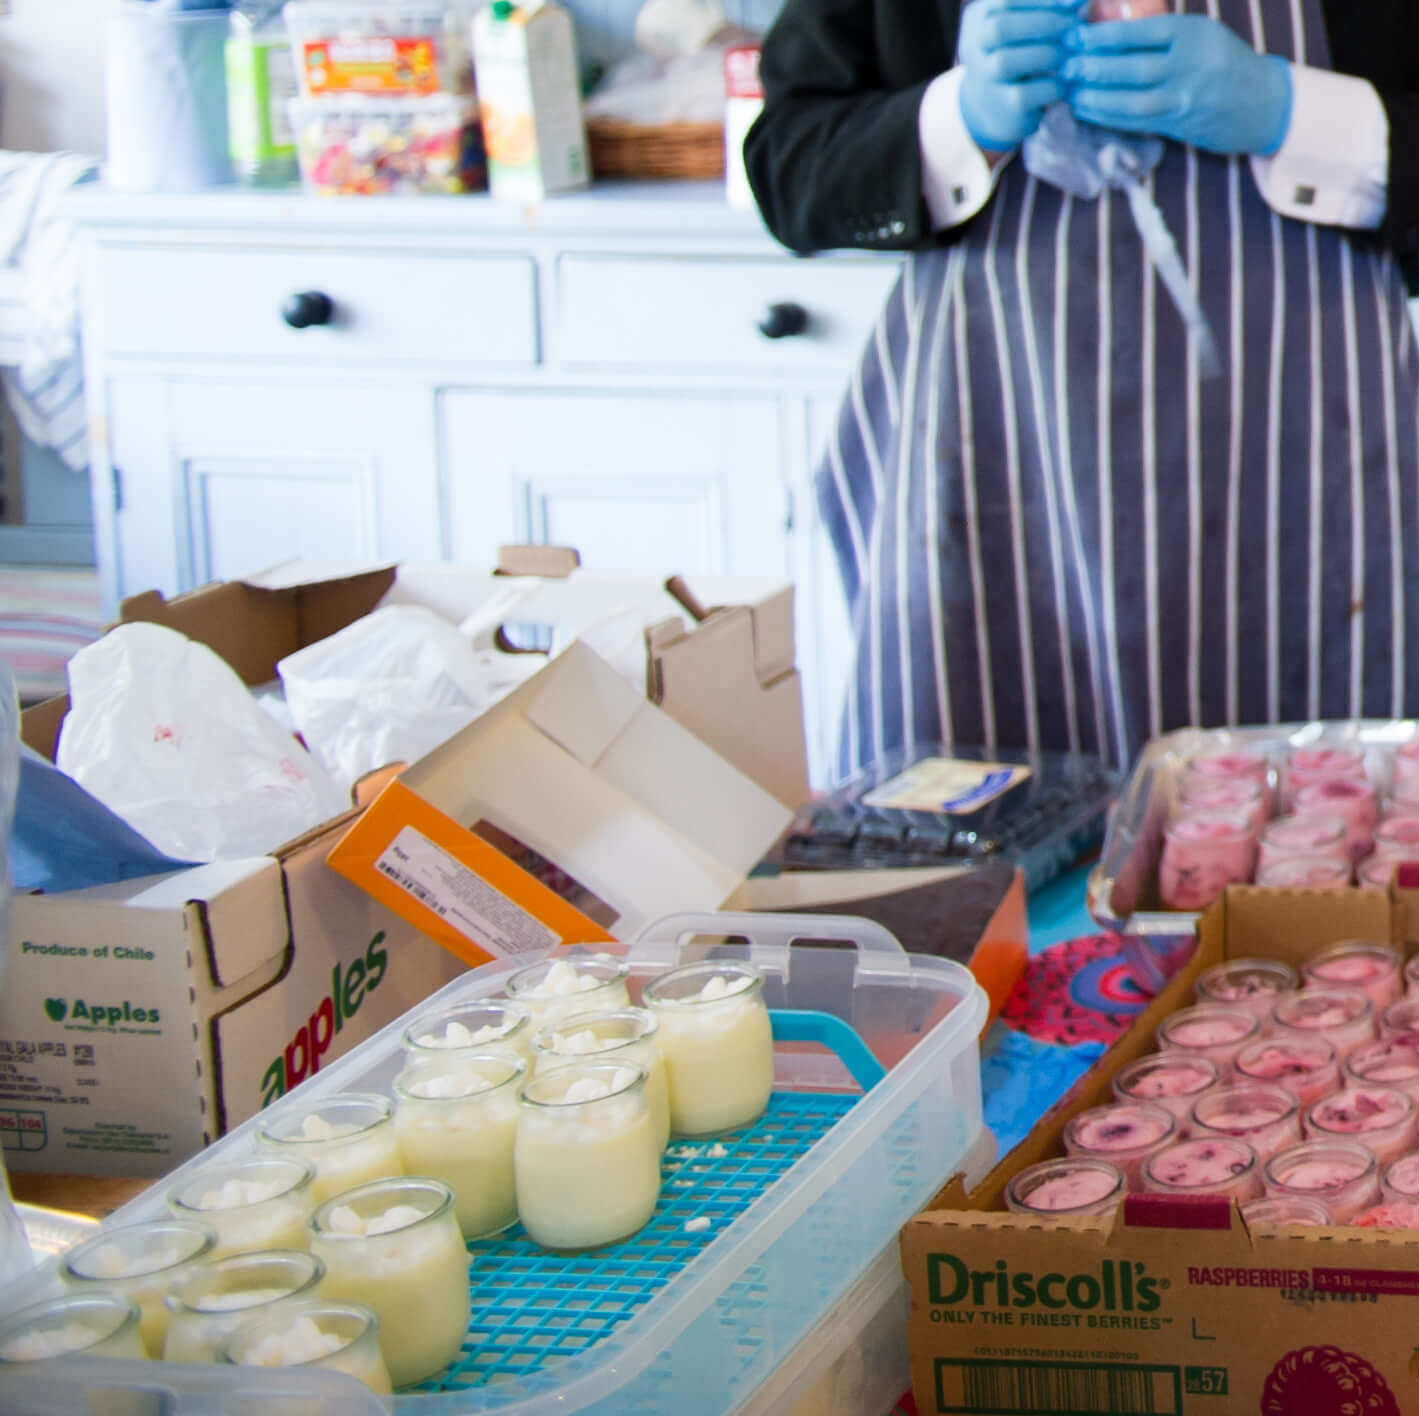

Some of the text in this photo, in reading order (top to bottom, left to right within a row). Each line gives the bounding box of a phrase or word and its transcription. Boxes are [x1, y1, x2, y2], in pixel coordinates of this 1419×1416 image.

[22, 941, 155, 961] Produce of Chile
[71, 999, 161, 1026] Apples
[260, 930, 388, 1111] apples
[927, 1253, 1162, 1313] Driscoll's
[1187, 1266, 1310, 1290] RASPBERRIES
[930, 1310, 976, 1325] ONLY
[980, 1311, 1015, 1325] THE
[1021, 1312, 1083, 1328] FINEST
[1201, 1370, 1225, 1393] 57
